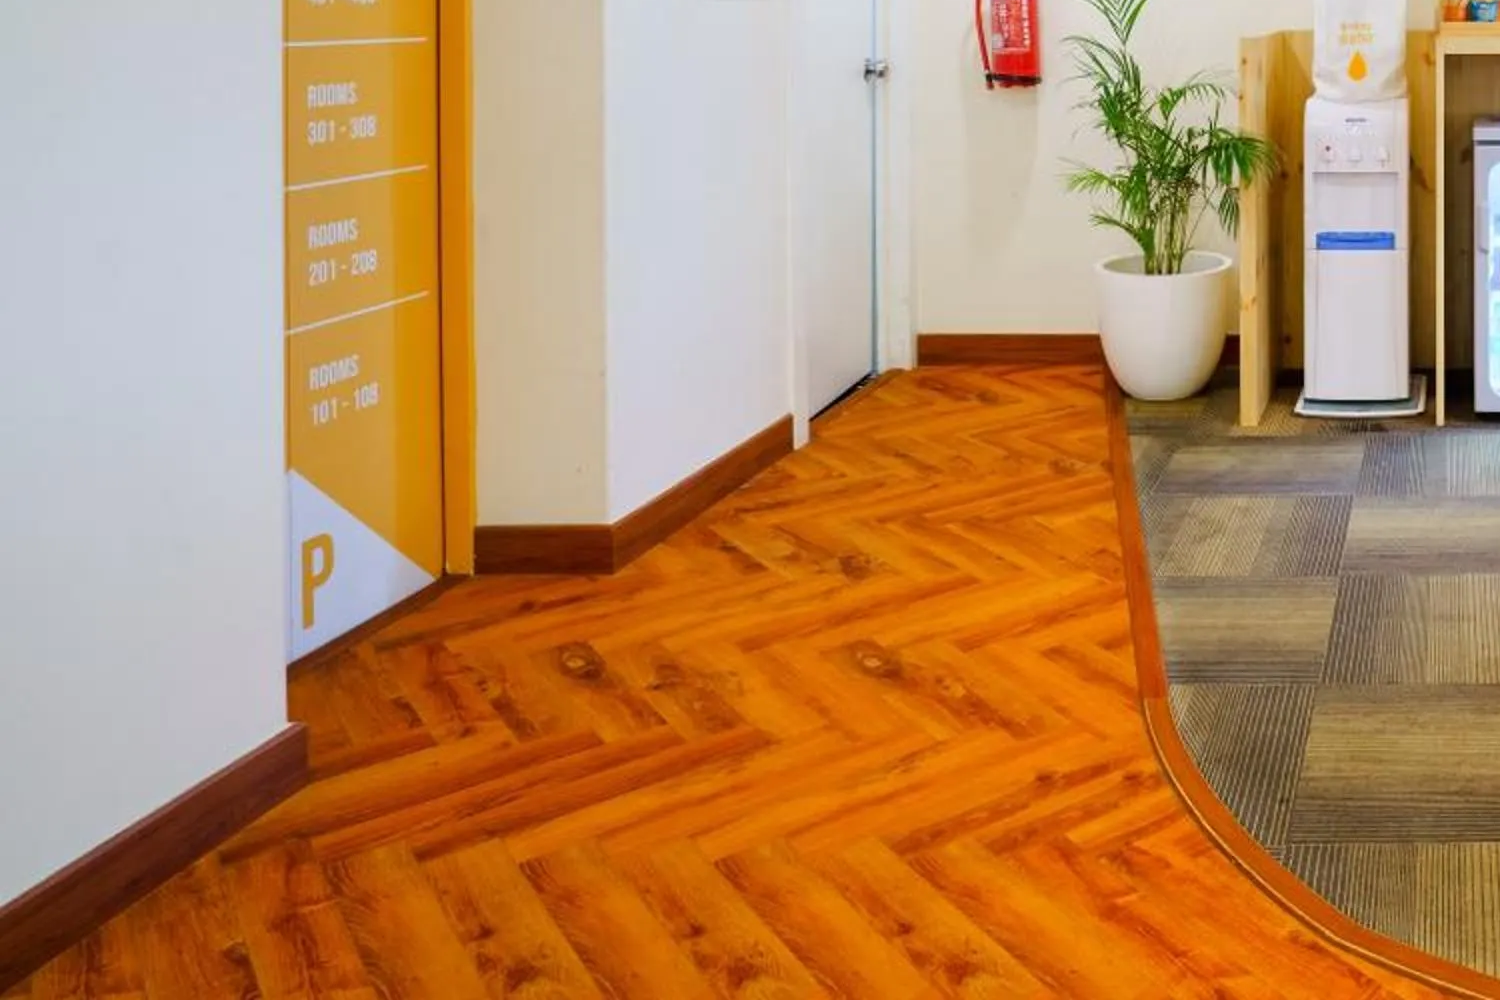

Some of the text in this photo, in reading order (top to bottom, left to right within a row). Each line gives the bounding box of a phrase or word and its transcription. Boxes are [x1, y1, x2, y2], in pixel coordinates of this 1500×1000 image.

[306, 80, 358, 109] ROOMS
[307, 119, 335, 146] 301
[308, 218, 359, 250] ROOMS
[308, 257, 336, 286] 201
[309, 354, 360, 391] ROOMS
[311, 397, 338, 426] 101
[302, 534, 335, 630] P
